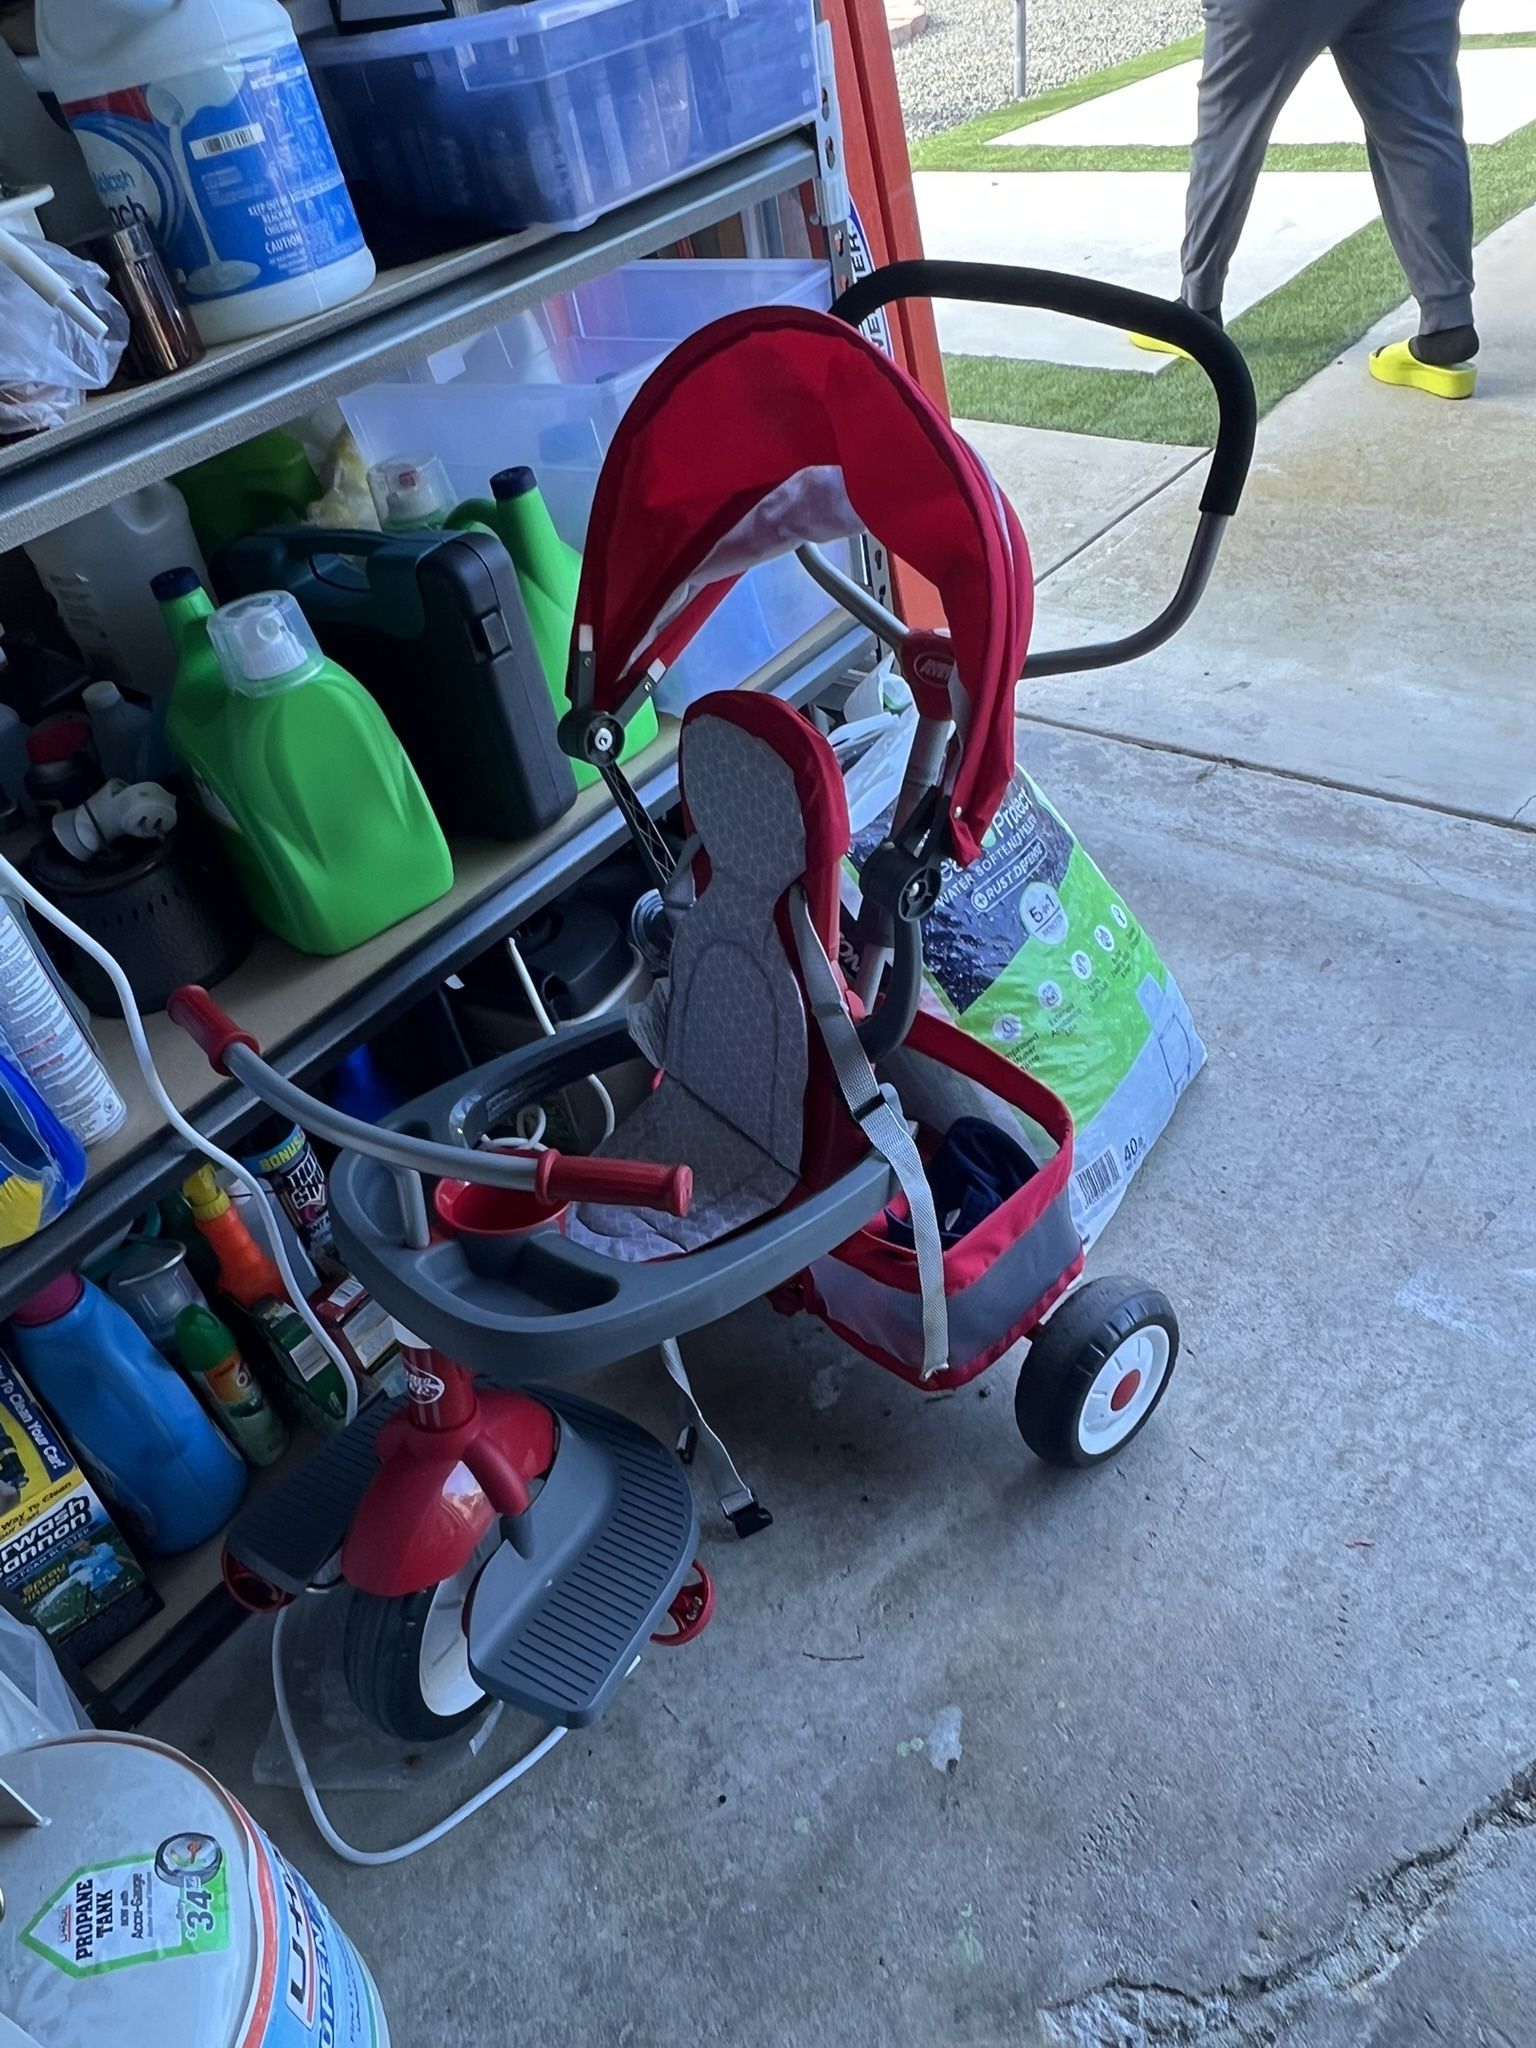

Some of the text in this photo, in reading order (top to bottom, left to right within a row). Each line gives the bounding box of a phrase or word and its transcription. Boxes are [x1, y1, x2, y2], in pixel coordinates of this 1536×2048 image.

[265, 231, 303, 254] CAUTION
[935, 873, 975, 907] WATER
[985, 873, 1016, 901] RUST
[1124, 1137, 1138, 1162] 40
[9, 1394, 33, 1423] Clean
[28, 1420, 49, 1446] Your
[43, 1445, 67, 1470] Car!
[1, 1511, 26, 1531] Way
[42, 1481, 73, 1503] Clean
[75, 1877, 94, 1962] PROPANE
[96, 1889, 114, 1939] TANK
